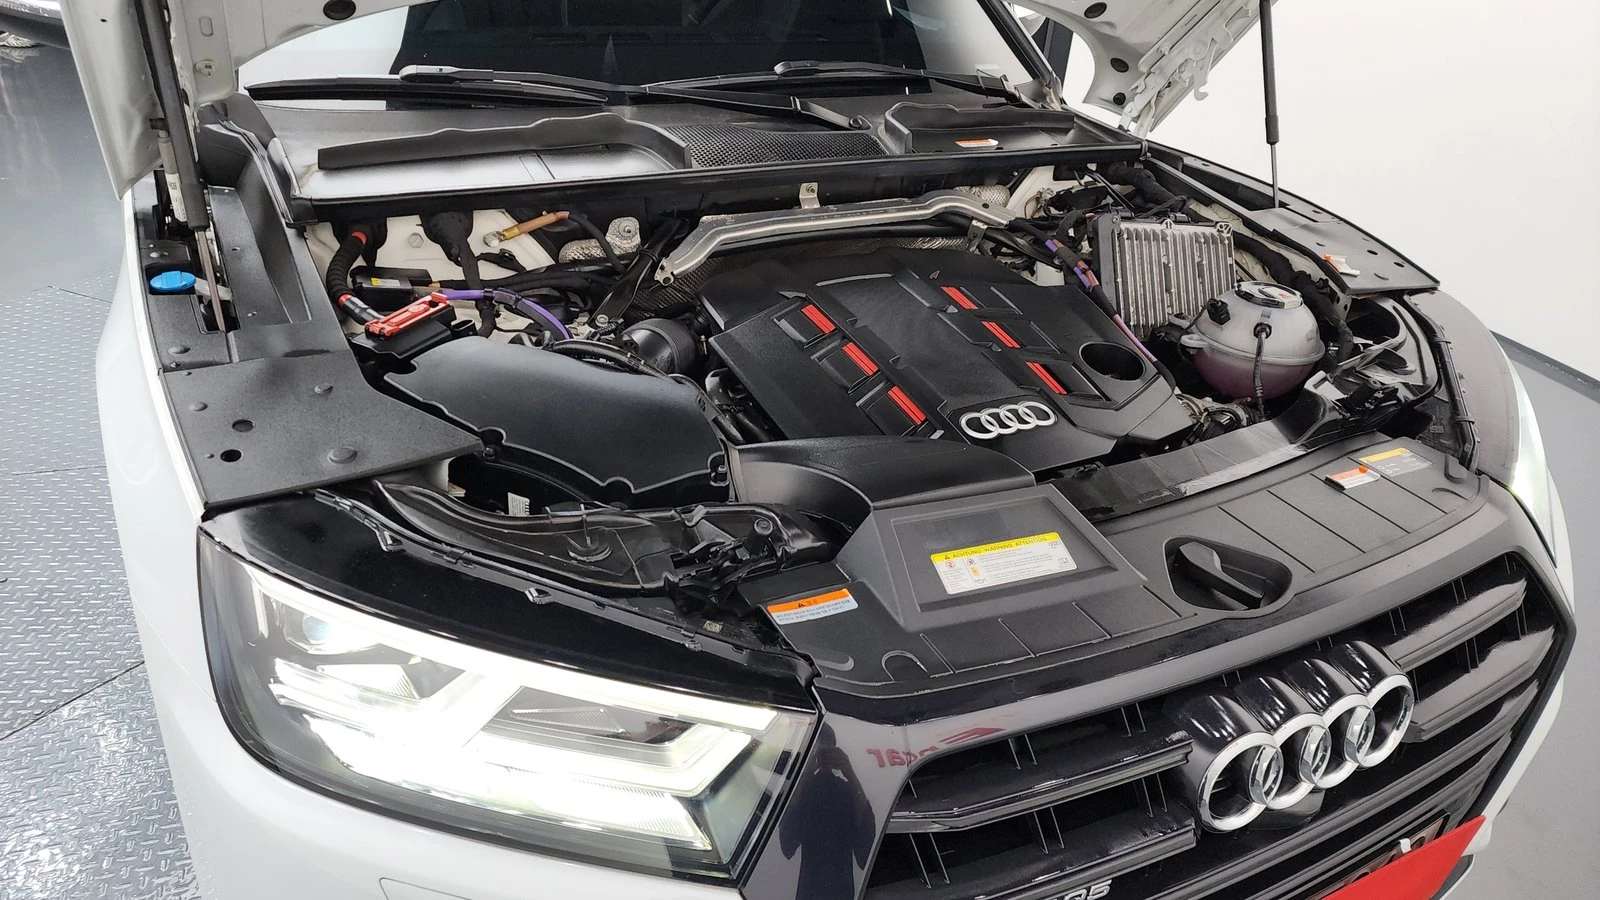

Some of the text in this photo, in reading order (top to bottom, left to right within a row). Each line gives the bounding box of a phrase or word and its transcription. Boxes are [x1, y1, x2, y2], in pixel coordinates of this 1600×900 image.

[952, 549, 982, 559] ACHTUNG
[984, 543, 1013, 553] WARNING
[1015, 537, 1047, 547] ATTENTION
